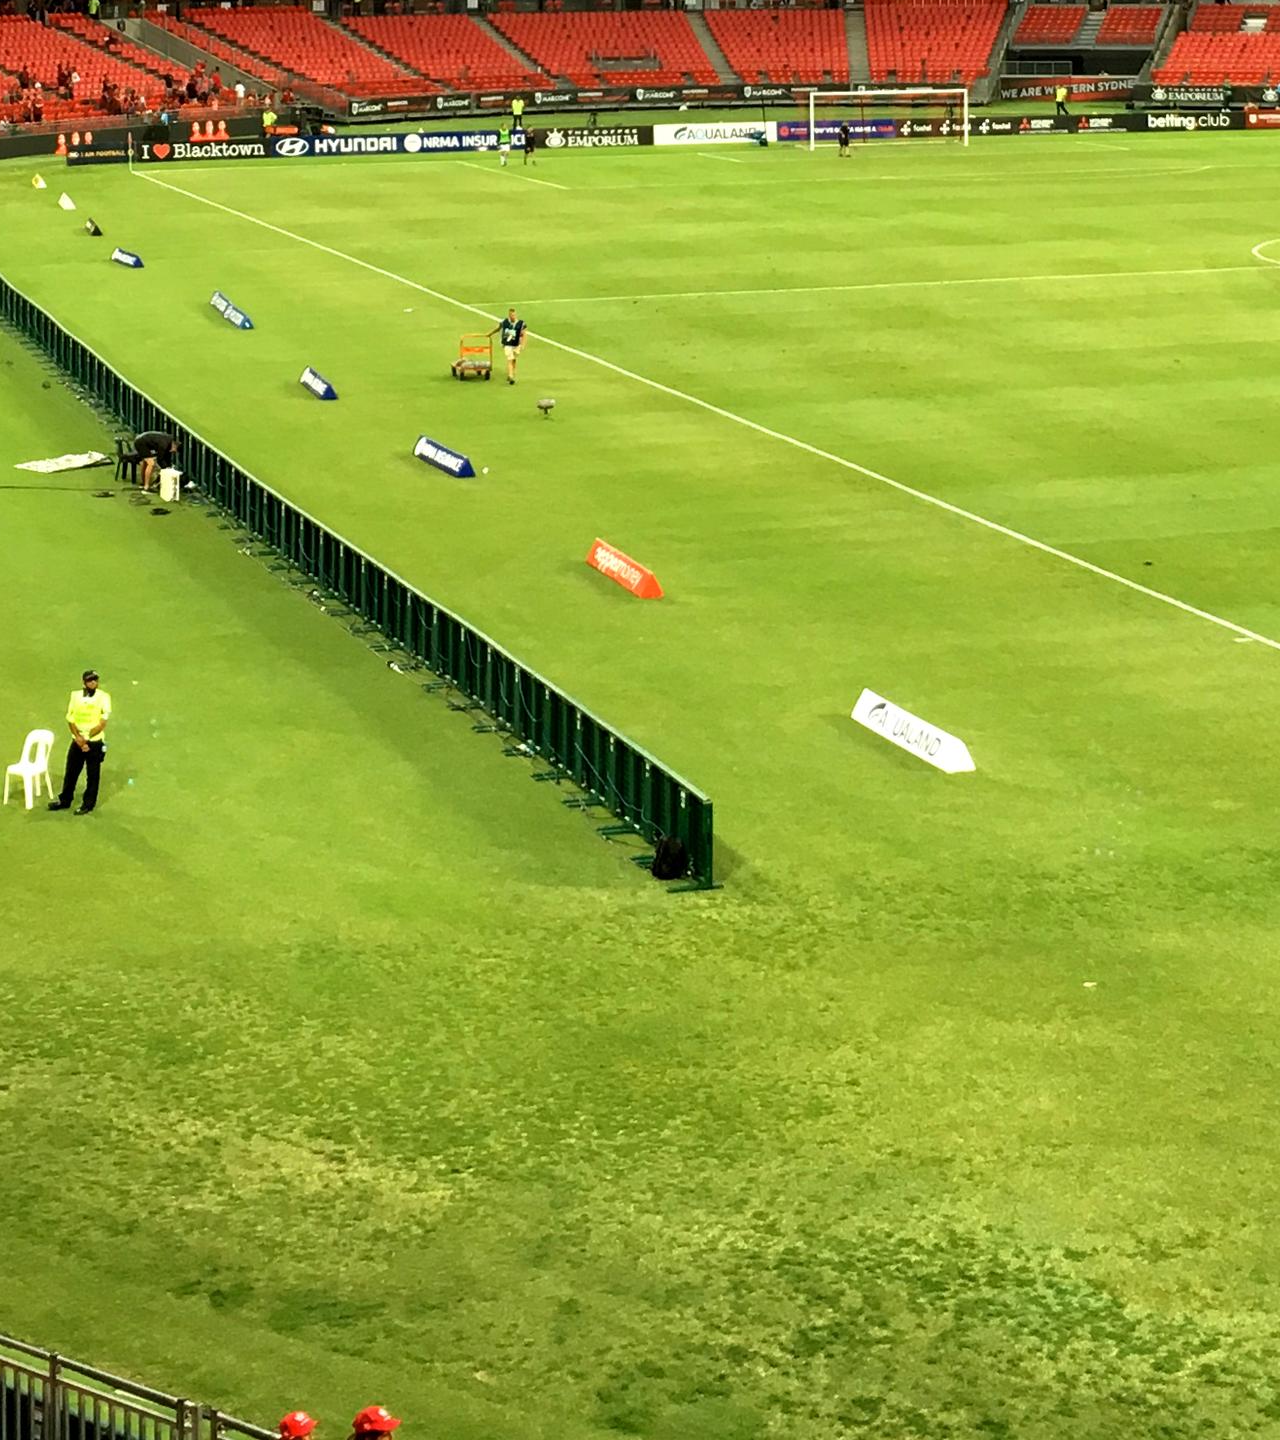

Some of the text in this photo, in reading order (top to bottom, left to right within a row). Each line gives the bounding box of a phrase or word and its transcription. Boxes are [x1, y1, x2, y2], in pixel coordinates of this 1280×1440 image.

[1001, 89, 1018, 99] WE
[1020, 86, 1042, 98] ARE
[1044, 82, 1095, 96] WERN
[1168, 92, 1224, 101] EMPORIUM
[913, 123, 932, 132] foxtel
[992, 122, 1011, 131] foxtel
[1147, 113, 1230, 130] betting.club
[314, 136, 398, 153] HYUNDAI
[423, 134, 526, 148] NRMA INSURC
[567, 135, 639, 147] EMPORIUM
[141, 142, 265, 160] I Blacktown
[878, 710, 942, 757] AUALAND
